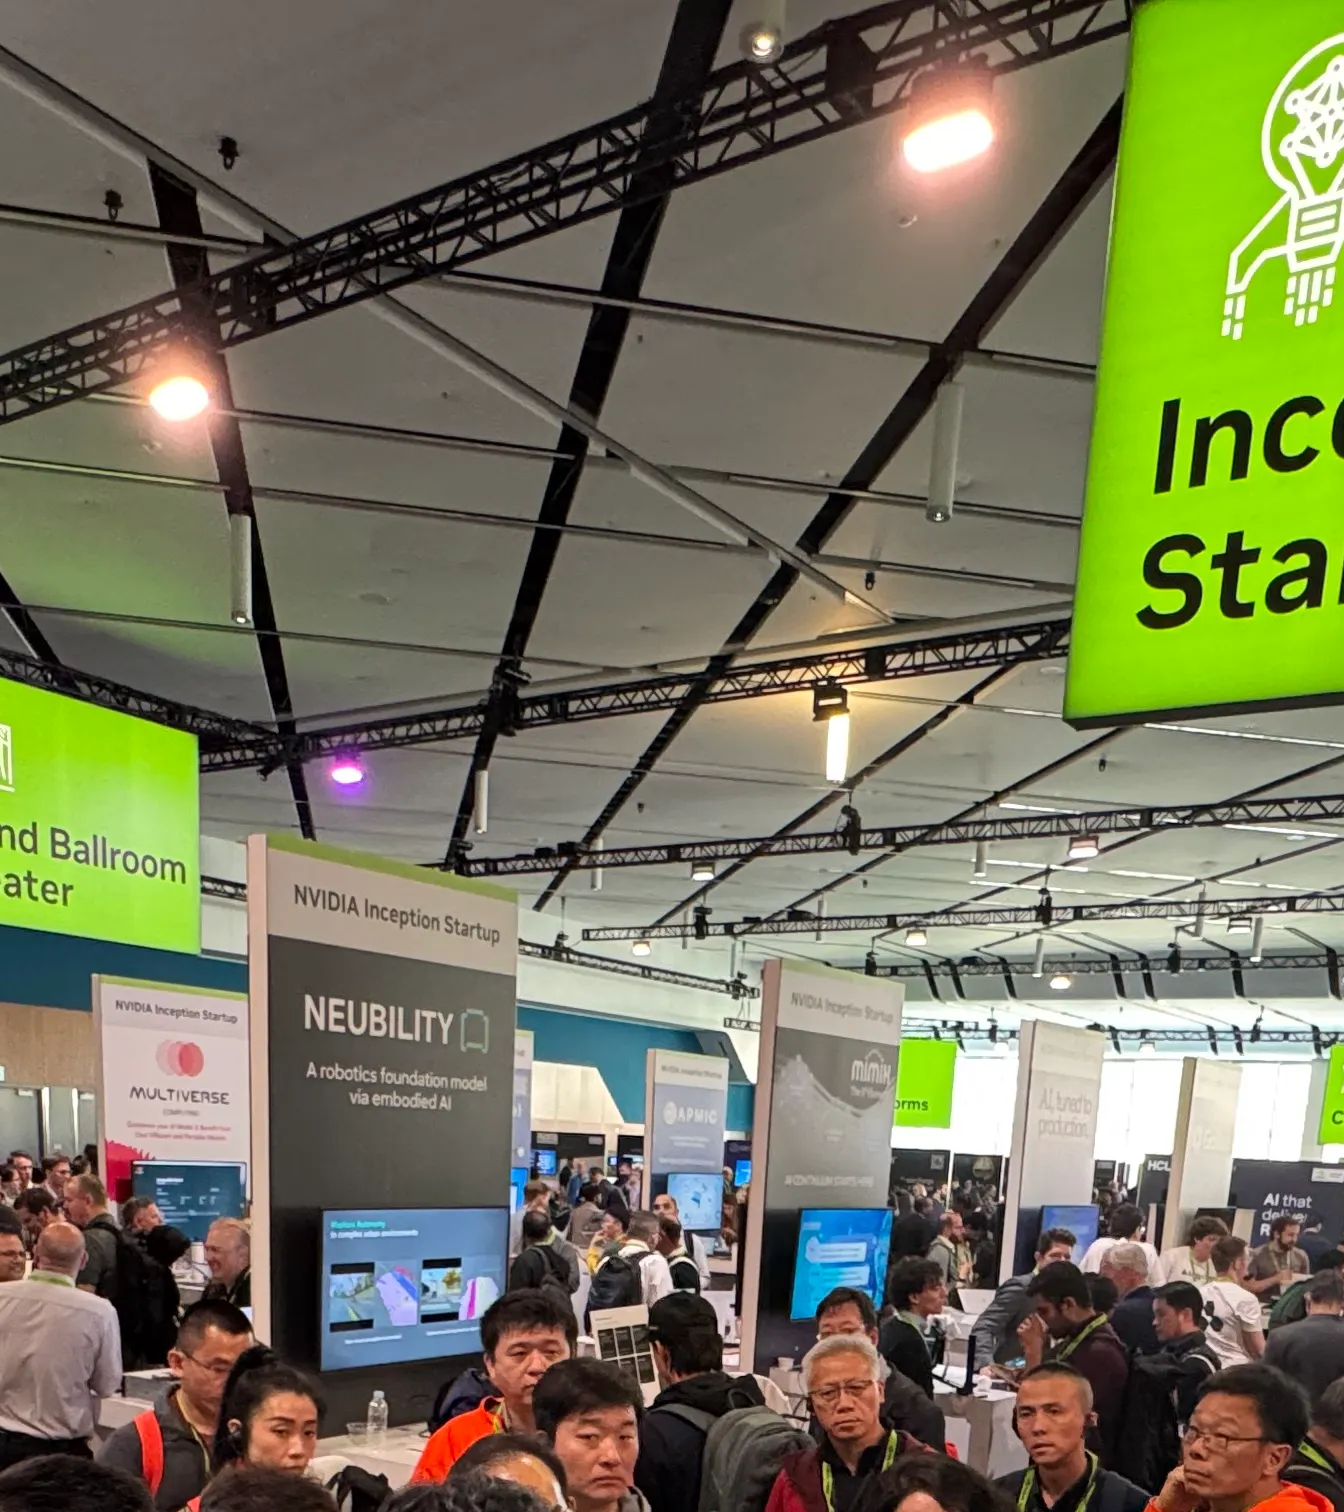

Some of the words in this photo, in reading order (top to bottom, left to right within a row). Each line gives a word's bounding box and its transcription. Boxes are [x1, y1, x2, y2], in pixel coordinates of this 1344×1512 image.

[50, 826, 187, 885] Ballroom
[294, 884, 359, 917] NVIDIA
[364, 899, 440, 931] Inception
[444, 915, 501, 947] Startup
[115, 1000, 152, 1014] NVIDIA
[155, 1004, 200, 1020] Inception
[202, 1010, 238, 1024] Startup
[304, 994, 455, 1045] NEUBILITY
[306, 1062, 318, 1078] A
[320, 1063, 378, 1084] robotics
[380, 1066, 448, 1089] foundation
[450, 1075, 488, 1092] model
[129, 1086, 230, 1105] MULTIVERSE
[349, 1089, 369, 1106] via
[372, 1090, 437, 1110] embodied
[439, 1095, 452, 1111] AI
[1263, 1193, 1279, 1206] AI
[1282, 1193, 1312, 1209] that
